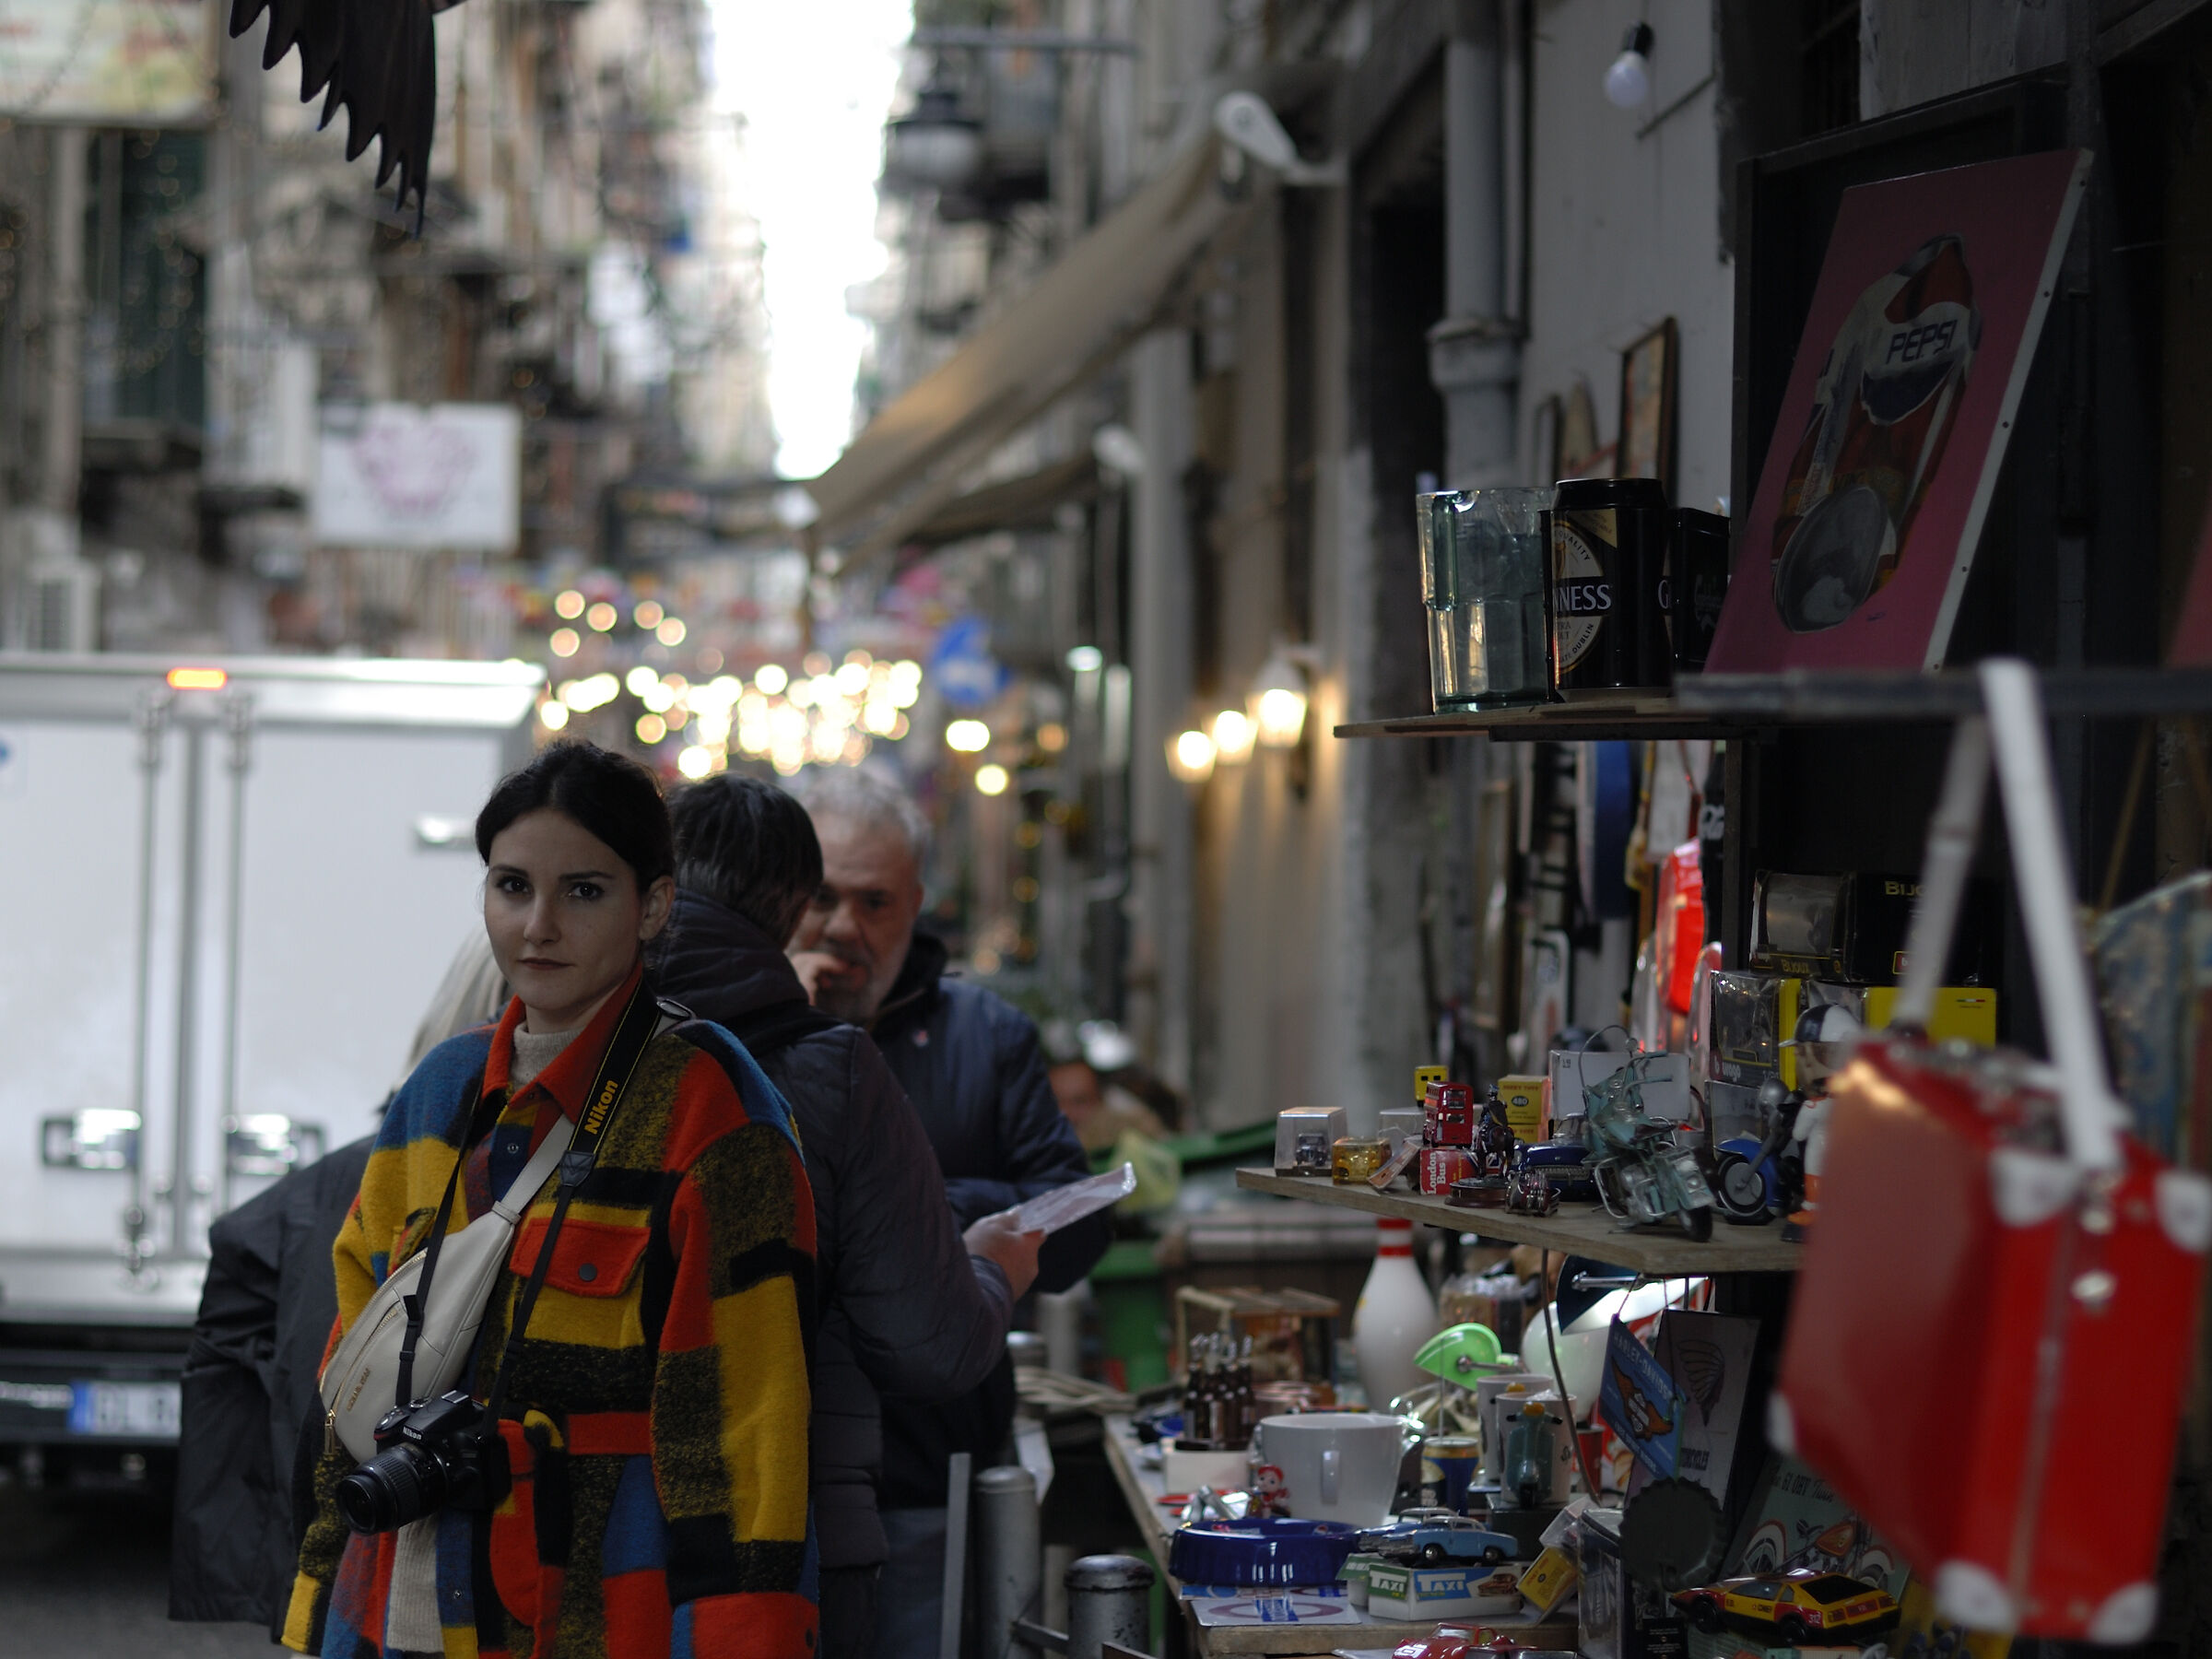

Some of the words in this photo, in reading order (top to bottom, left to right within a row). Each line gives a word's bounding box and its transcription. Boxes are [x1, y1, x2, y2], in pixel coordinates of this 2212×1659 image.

[1886, 319, 1958, 365] PEPSI
[1571, 622, 1594, 654] DUBLIN
[1884, 880, 1928, 897] BIJO
[583, 1078, 619, 1135] Nikon
[1427, 1151, 1437, 1194] London
[1437, 1161, 1446, 1184] Bus
[403, 1426, 423, 1441] Nikon
[1369, 1570, 1408, 1594] TAXI
[1417, 1572, 1466, 1593] TAXI
